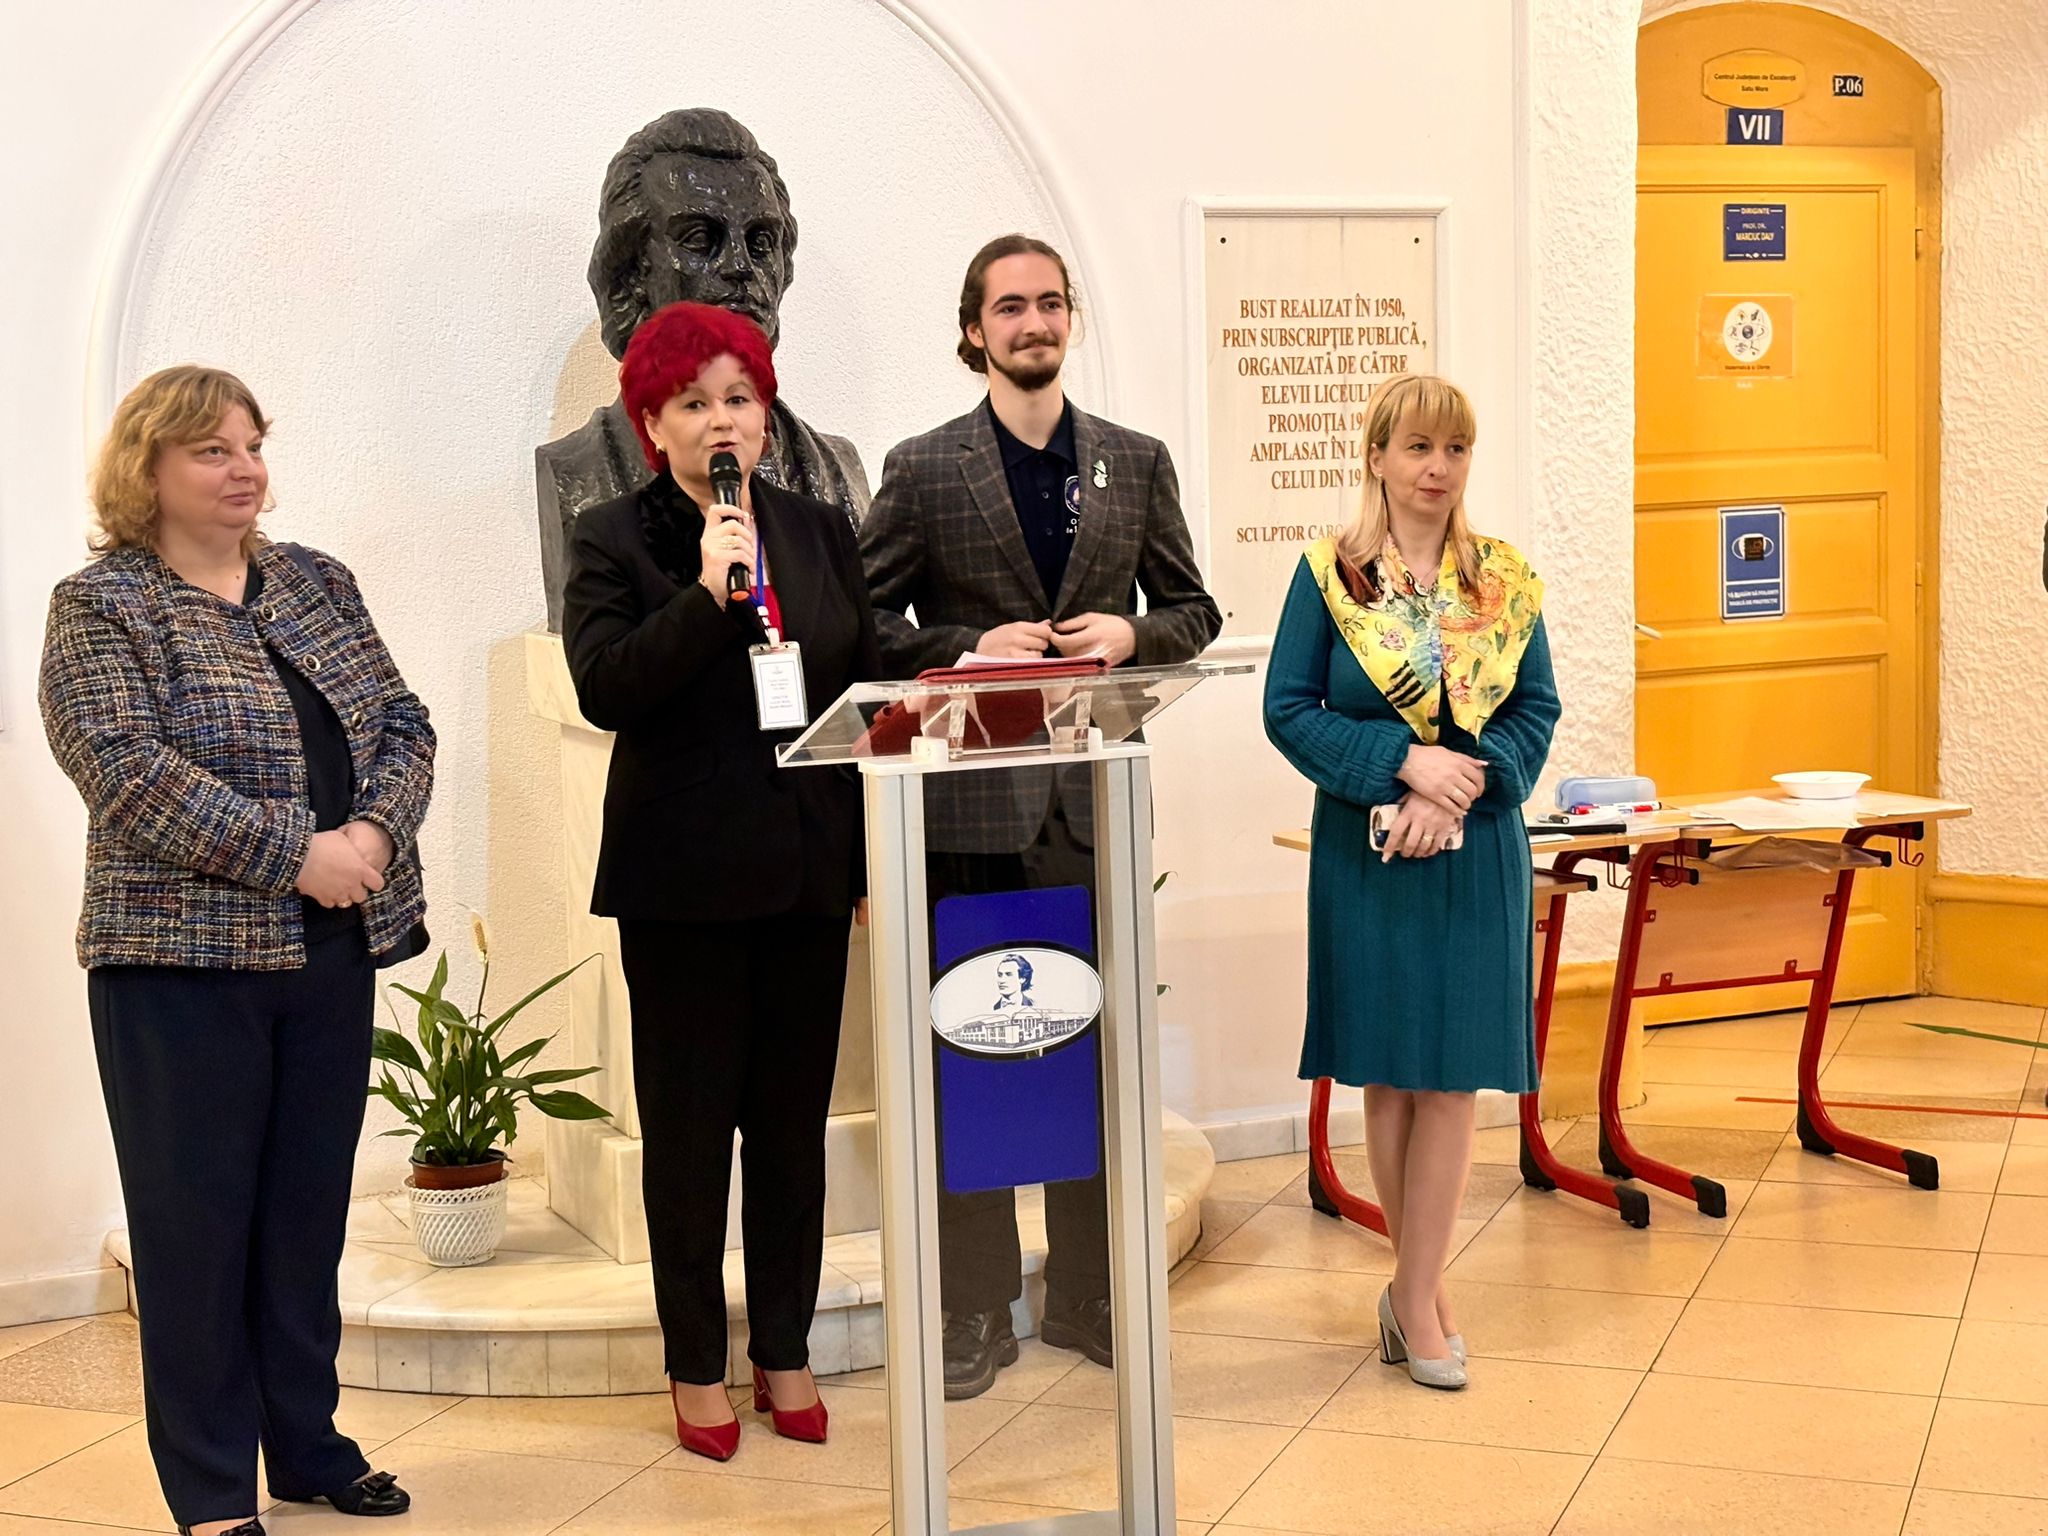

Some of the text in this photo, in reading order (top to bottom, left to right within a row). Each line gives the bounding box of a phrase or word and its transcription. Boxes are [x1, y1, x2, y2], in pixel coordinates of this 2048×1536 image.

[1834, 77, 1863, 94] P.06
[1738, 114, 1771, 141] VII
[1240, 292, 1406, 321] BUST REALIZAT ÎN 1950,
[1222, 328, 1257, 348] PRIN
[1337, 355, 1357, 375] DE
[1261, 385, 1311, 405] ELEVII
[1350, 411, 1364, 432] 19
[1250, 441, 1328, 462] AMPLASAT
[1330, 435, 1346, 460] ÎN
[1271, 467, 1362, 490] CELUI DIN 19
[1236, 525, 1305, 543] SCULPTOR
